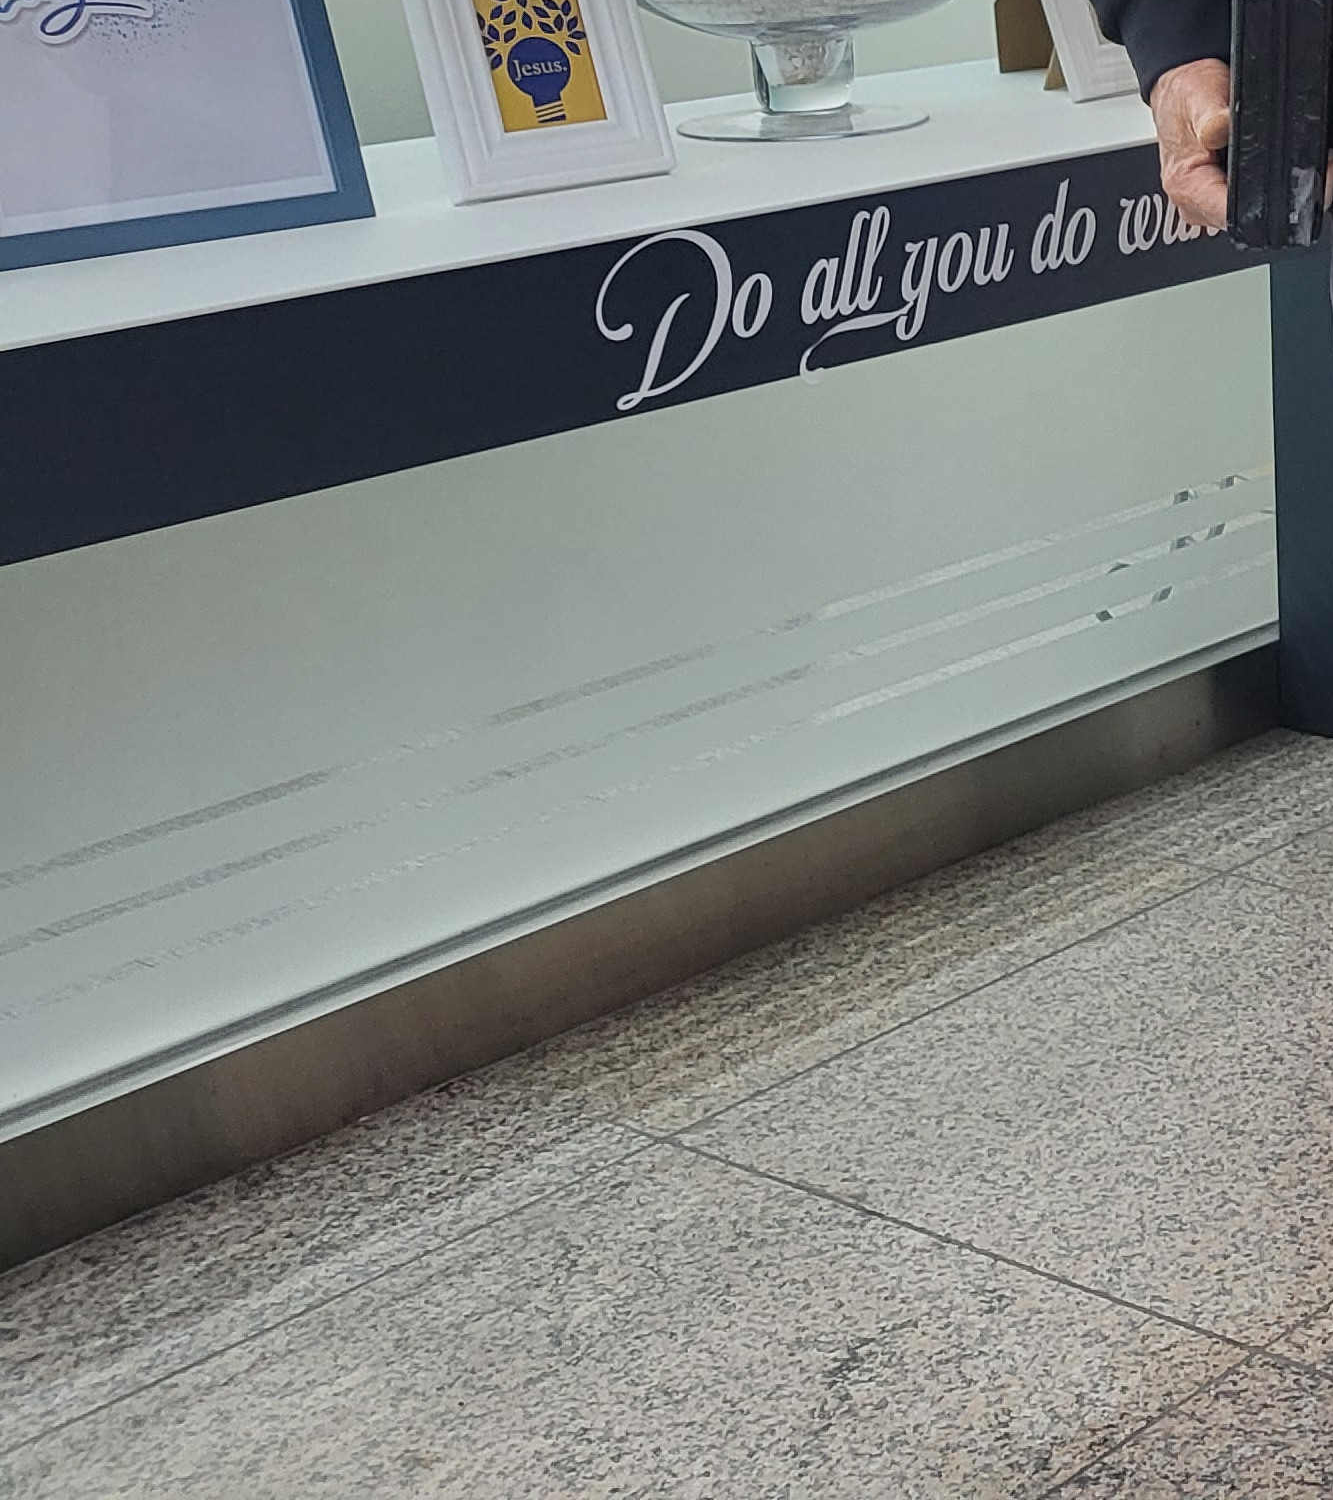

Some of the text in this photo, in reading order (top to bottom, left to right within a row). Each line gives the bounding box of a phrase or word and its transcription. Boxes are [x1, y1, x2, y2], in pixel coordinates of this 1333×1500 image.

[511, 58, 569, 82] Jesus.
[800, 205, 892, 326] all
[1029, 178, 1097, 275] do
[596, 229, 773, 411] Do
[799, 219, 1015, 385] you
